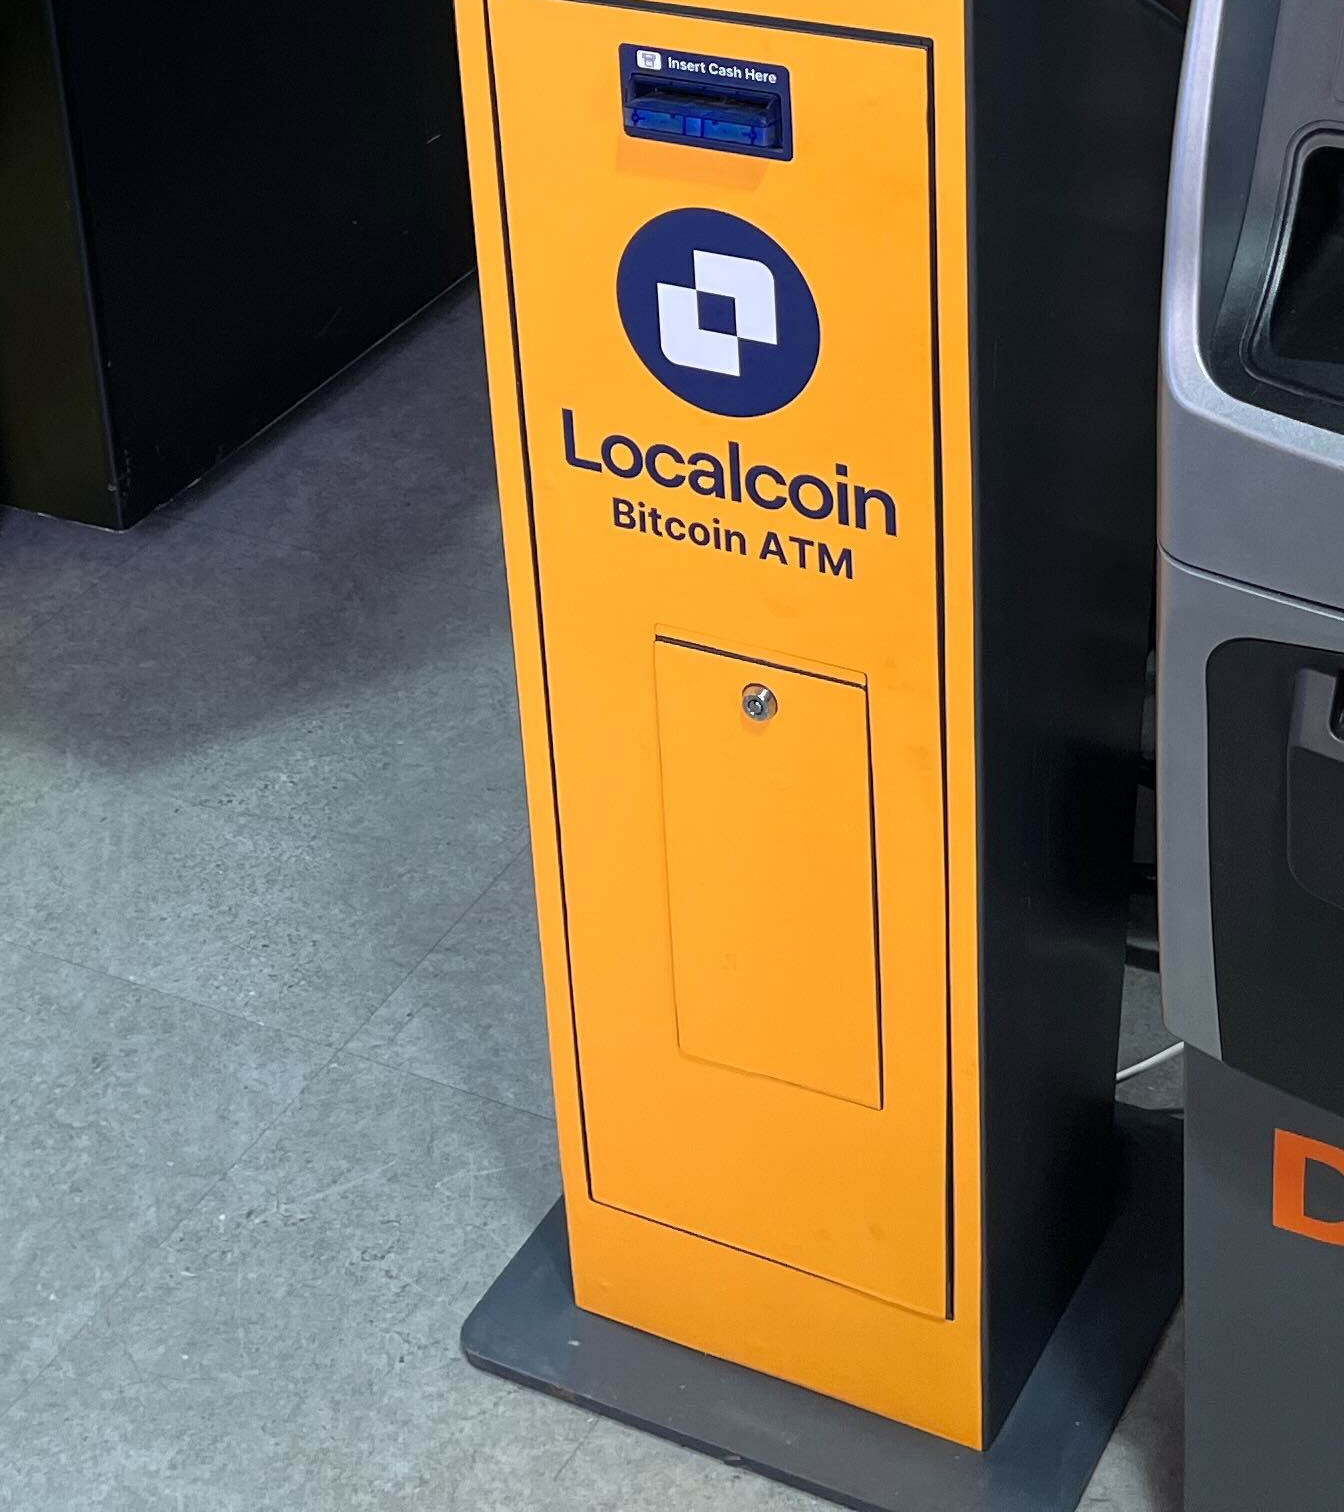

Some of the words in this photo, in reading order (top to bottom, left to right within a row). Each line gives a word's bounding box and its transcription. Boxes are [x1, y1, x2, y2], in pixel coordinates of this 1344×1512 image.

[668, 56, 707, 74] Insert
[708, 62, 743, 79] Cash
[744, 67, 778, 84] Here
[561, 407, 897, 538] Localcoin
[611, 496, 748, 557] Bitcoin
[758, 529, 855, 581] ATM
